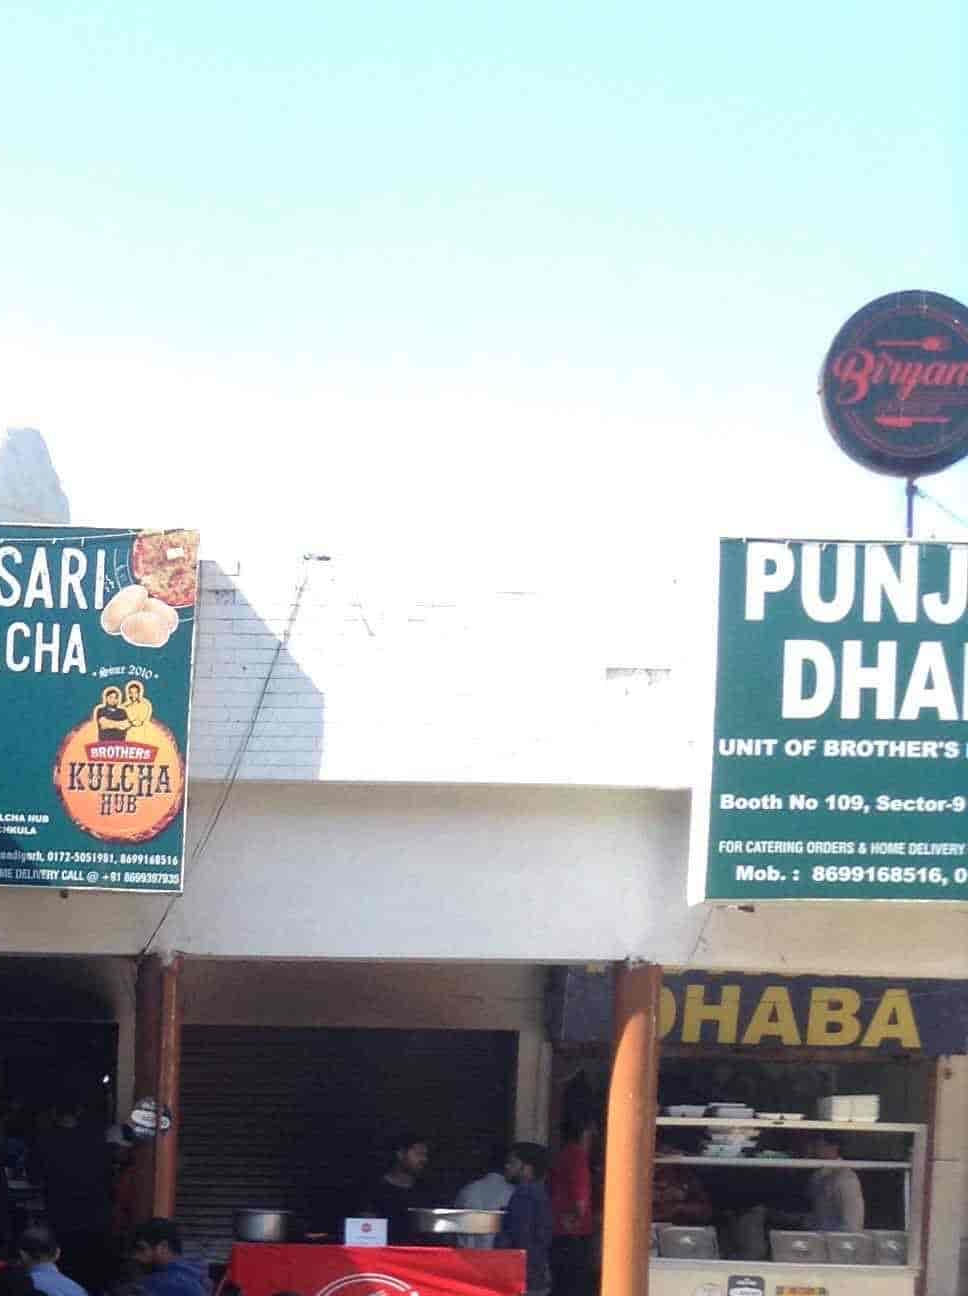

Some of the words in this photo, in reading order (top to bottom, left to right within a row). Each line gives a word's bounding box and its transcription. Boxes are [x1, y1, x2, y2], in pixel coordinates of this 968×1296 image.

[744, 541, 968, 625] PUNJ
[782, 639, 968, 721] DHA
[90, 746, 152, 761] BROTHERS
[718, 738, 778, 757] UNIT
[784, 739, 817, 757] OF
[823, 739, 960, 759] BROTHER'S
[67, 762, 172, 797] KULCHA
[99, 793, 137, 816] HUB
[719, 793, 782, 811] Booth
[788, 794, 819, 811] No
[824, 794, 870, 814] 109,
[875, 795, 967, 813] Sector-9
[27, 814, 50, 824] HUB
[718, 840, 743, 853] FOR
[745, 840, 804, 855] CATERING
[806, 841, 855, 855] ORDERS
[857, 842, 868, 855] &
[870, 842, 906, 856] HOME
[907, 843, 965, 857] DELIVERY
[15, 868, 60, 881] DELIVERY
[61, 869, 84, 882] CALL
[86, 871, 100, 883] @
[811, 865, 949, 886] 8699168516,
